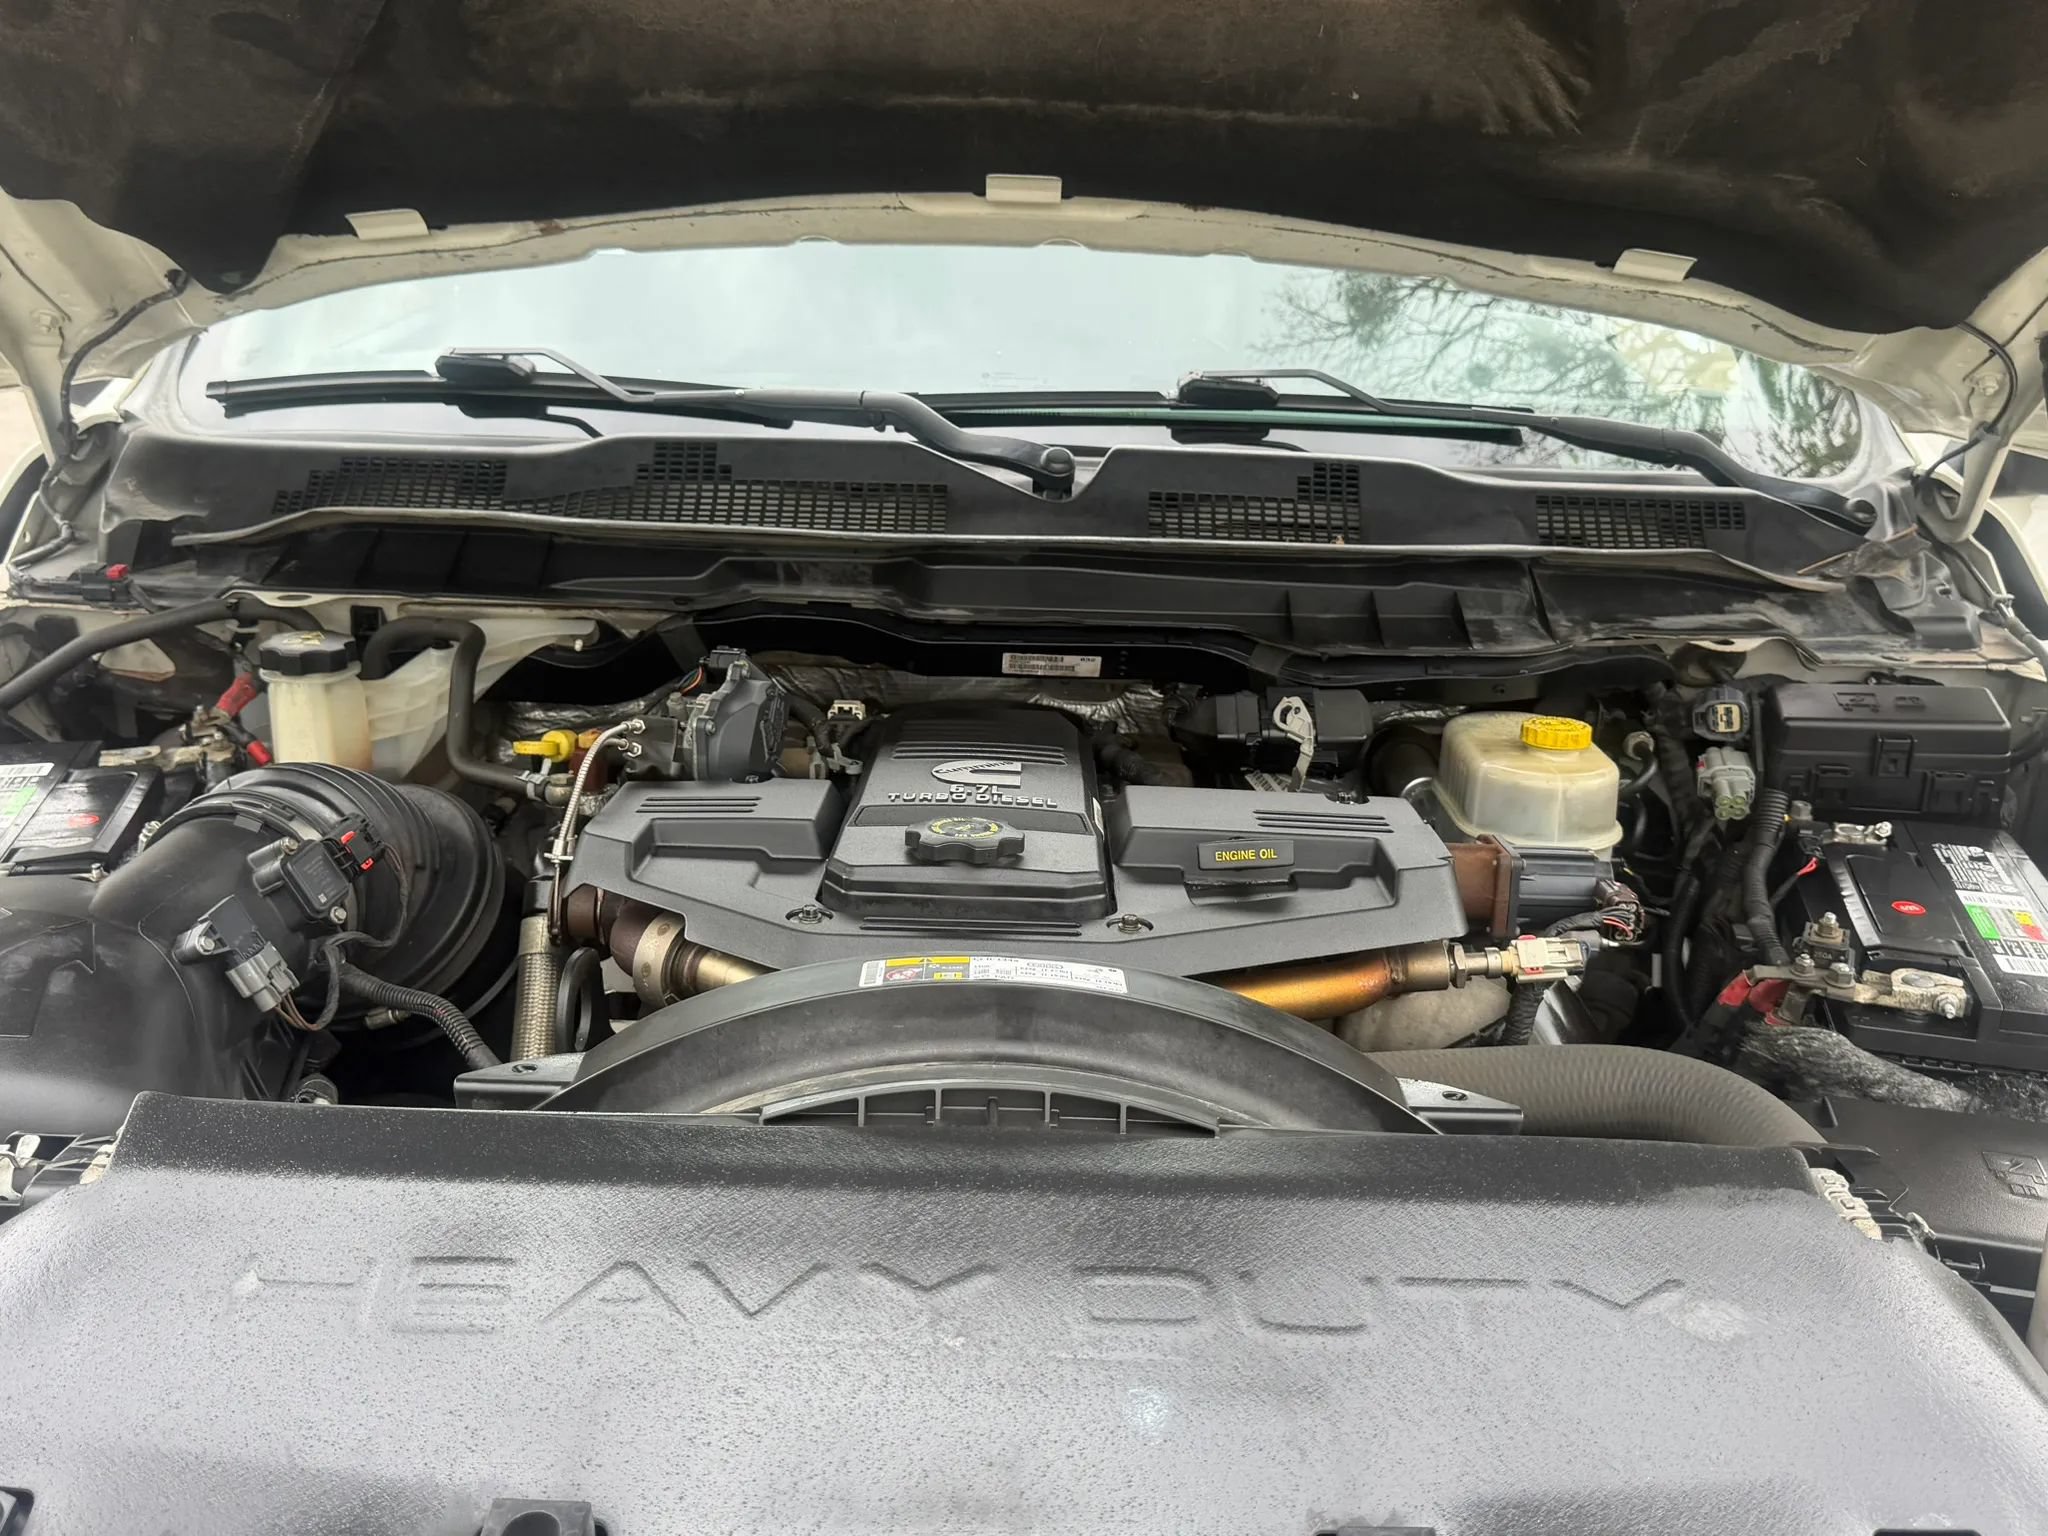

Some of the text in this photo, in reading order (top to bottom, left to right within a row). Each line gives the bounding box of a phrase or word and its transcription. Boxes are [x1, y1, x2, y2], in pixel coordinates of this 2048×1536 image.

[888, 792, 1058, 808] TURBO DIESEL
[1215, 848, 1278, 861] ENGINE OIL
[222, 1252, 1688, 1352] HEAVY DUTY
